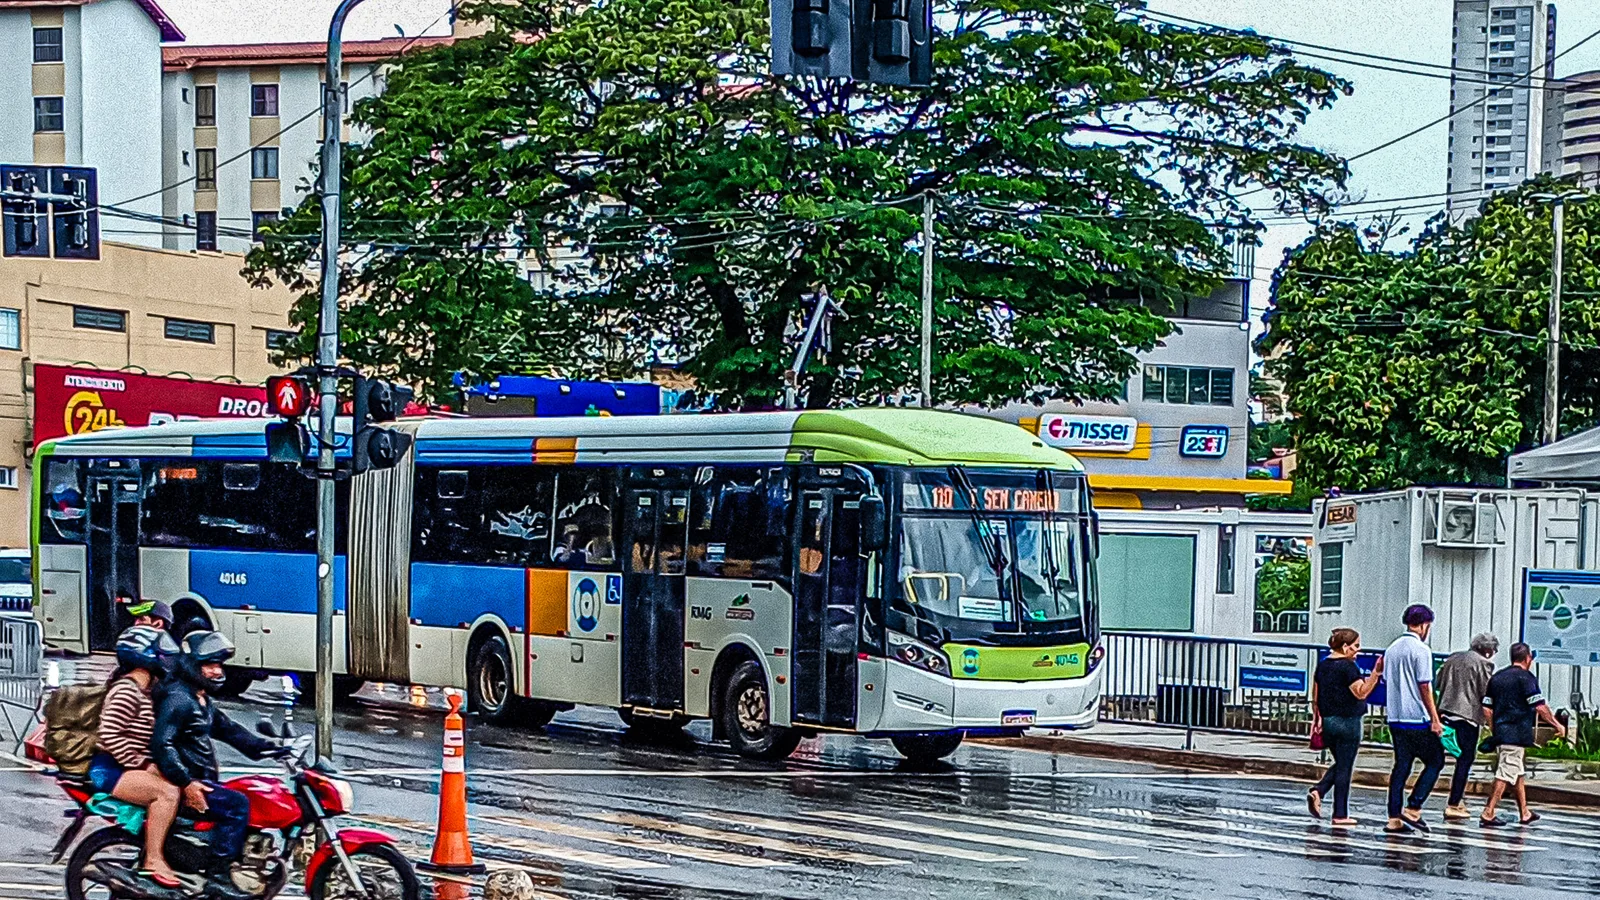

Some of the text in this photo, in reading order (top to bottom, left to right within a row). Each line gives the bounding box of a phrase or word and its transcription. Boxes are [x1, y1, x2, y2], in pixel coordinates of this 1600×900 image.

[1068, 421, 1130, 441] nissei
[931, 486, 954, 509] 110
[219, 572, 247, 585] 40146
